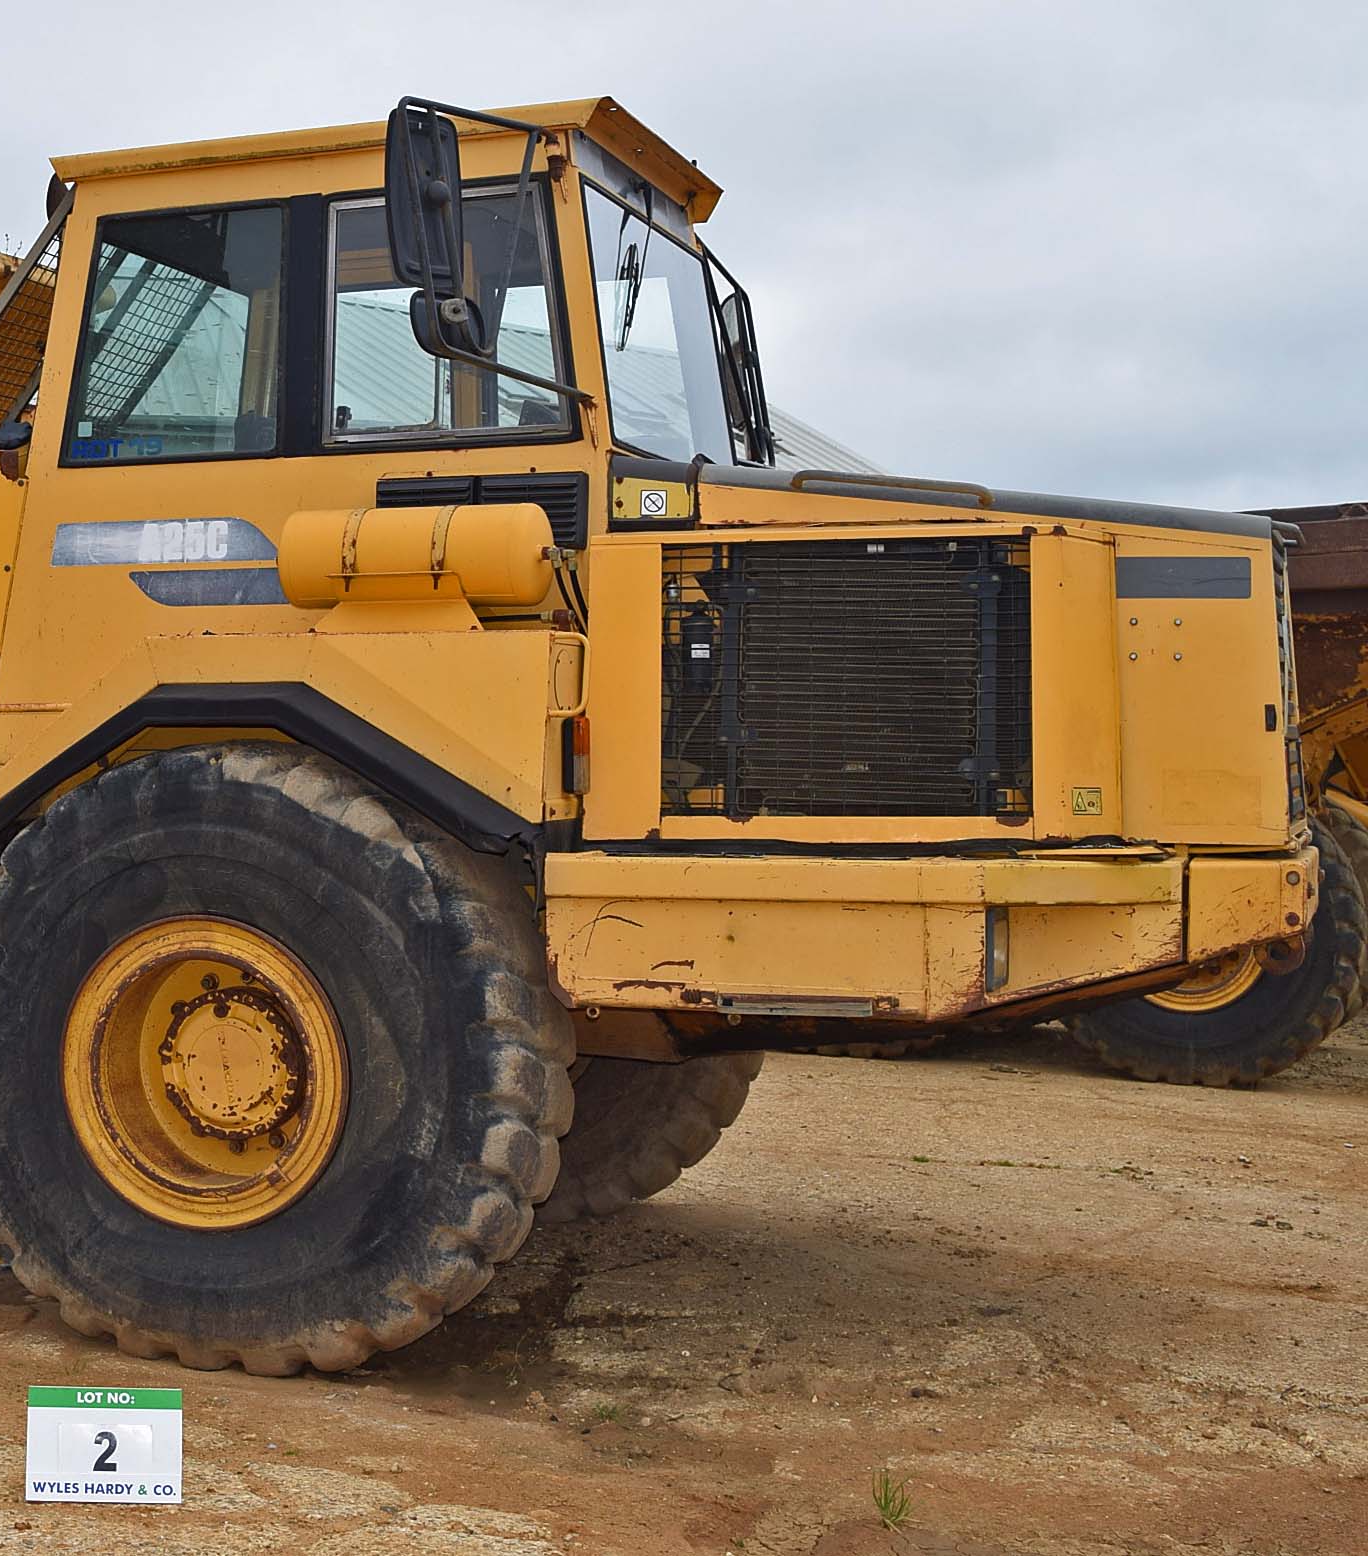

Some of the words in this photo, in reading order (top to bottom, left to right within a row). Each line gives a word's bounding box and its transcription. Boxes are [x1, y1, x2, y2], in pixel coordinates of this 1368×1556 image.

[77, 1391, 103, 1404] LOT
[107, 1392, 135, 1404] NO:
[92, 1431, 118, 1472] 2
[32, 1481, 79, 1494] WYLES
[84, 1482, 133, 1495] HARDY
[138, 1484, 148, 1495] &
[153, 1484, 177, 1496] CO.
